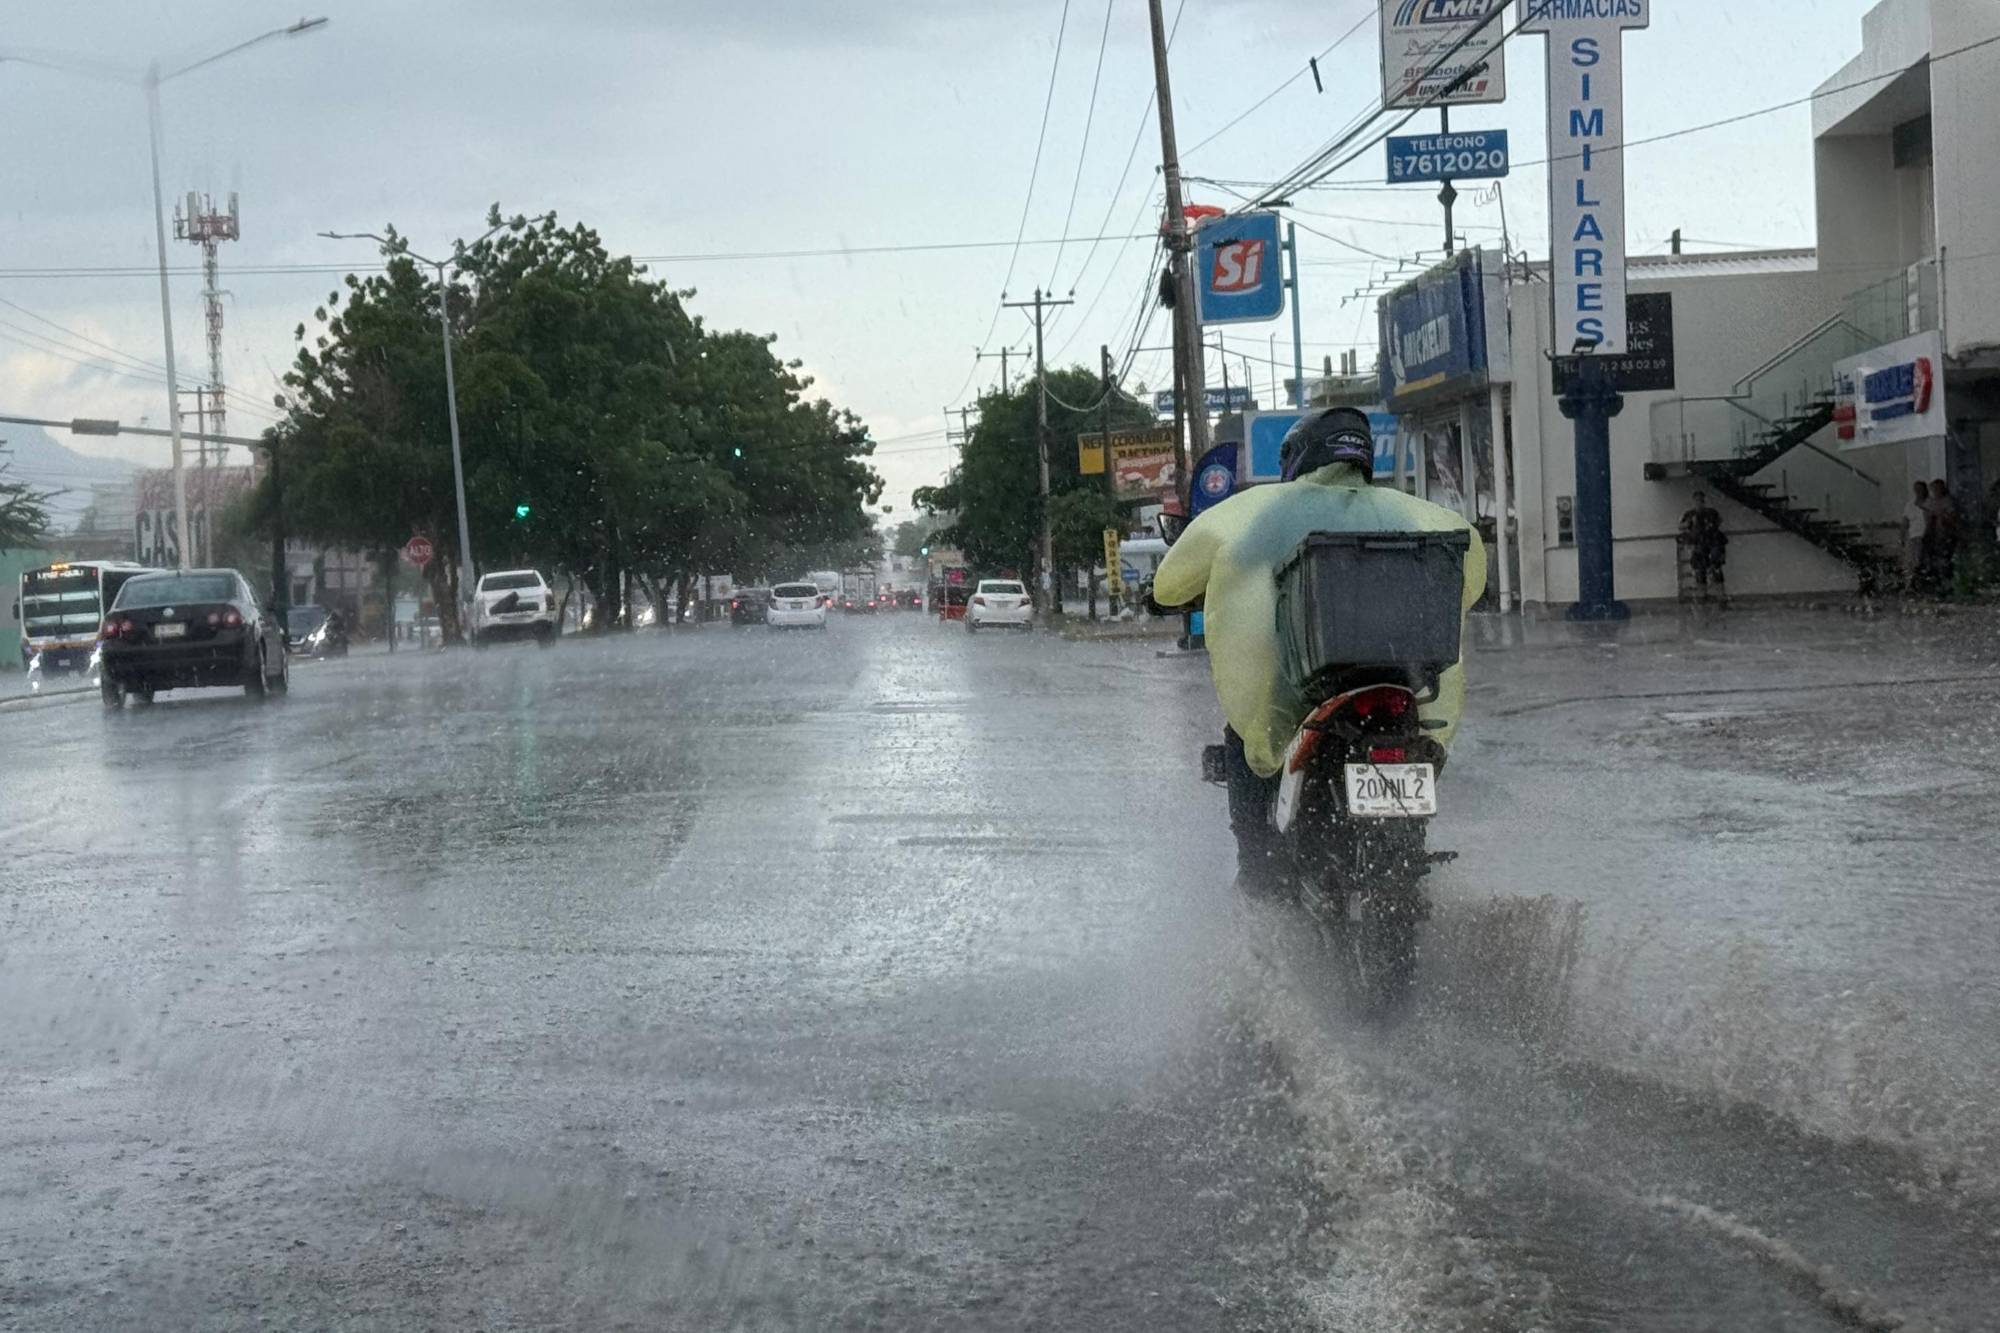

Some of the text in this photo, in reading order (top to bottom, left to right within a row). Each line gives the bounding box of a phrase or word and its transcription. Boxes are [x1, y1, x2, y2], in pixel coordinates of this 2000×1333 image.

[1527, 0, 1641, 19] FARMACIAS
[1410, 135, 1486, 152] TELÉFONO
[1404, 149, 1505, 175] 7612020
[1569, 37, 1604, 347] SIMILARES
